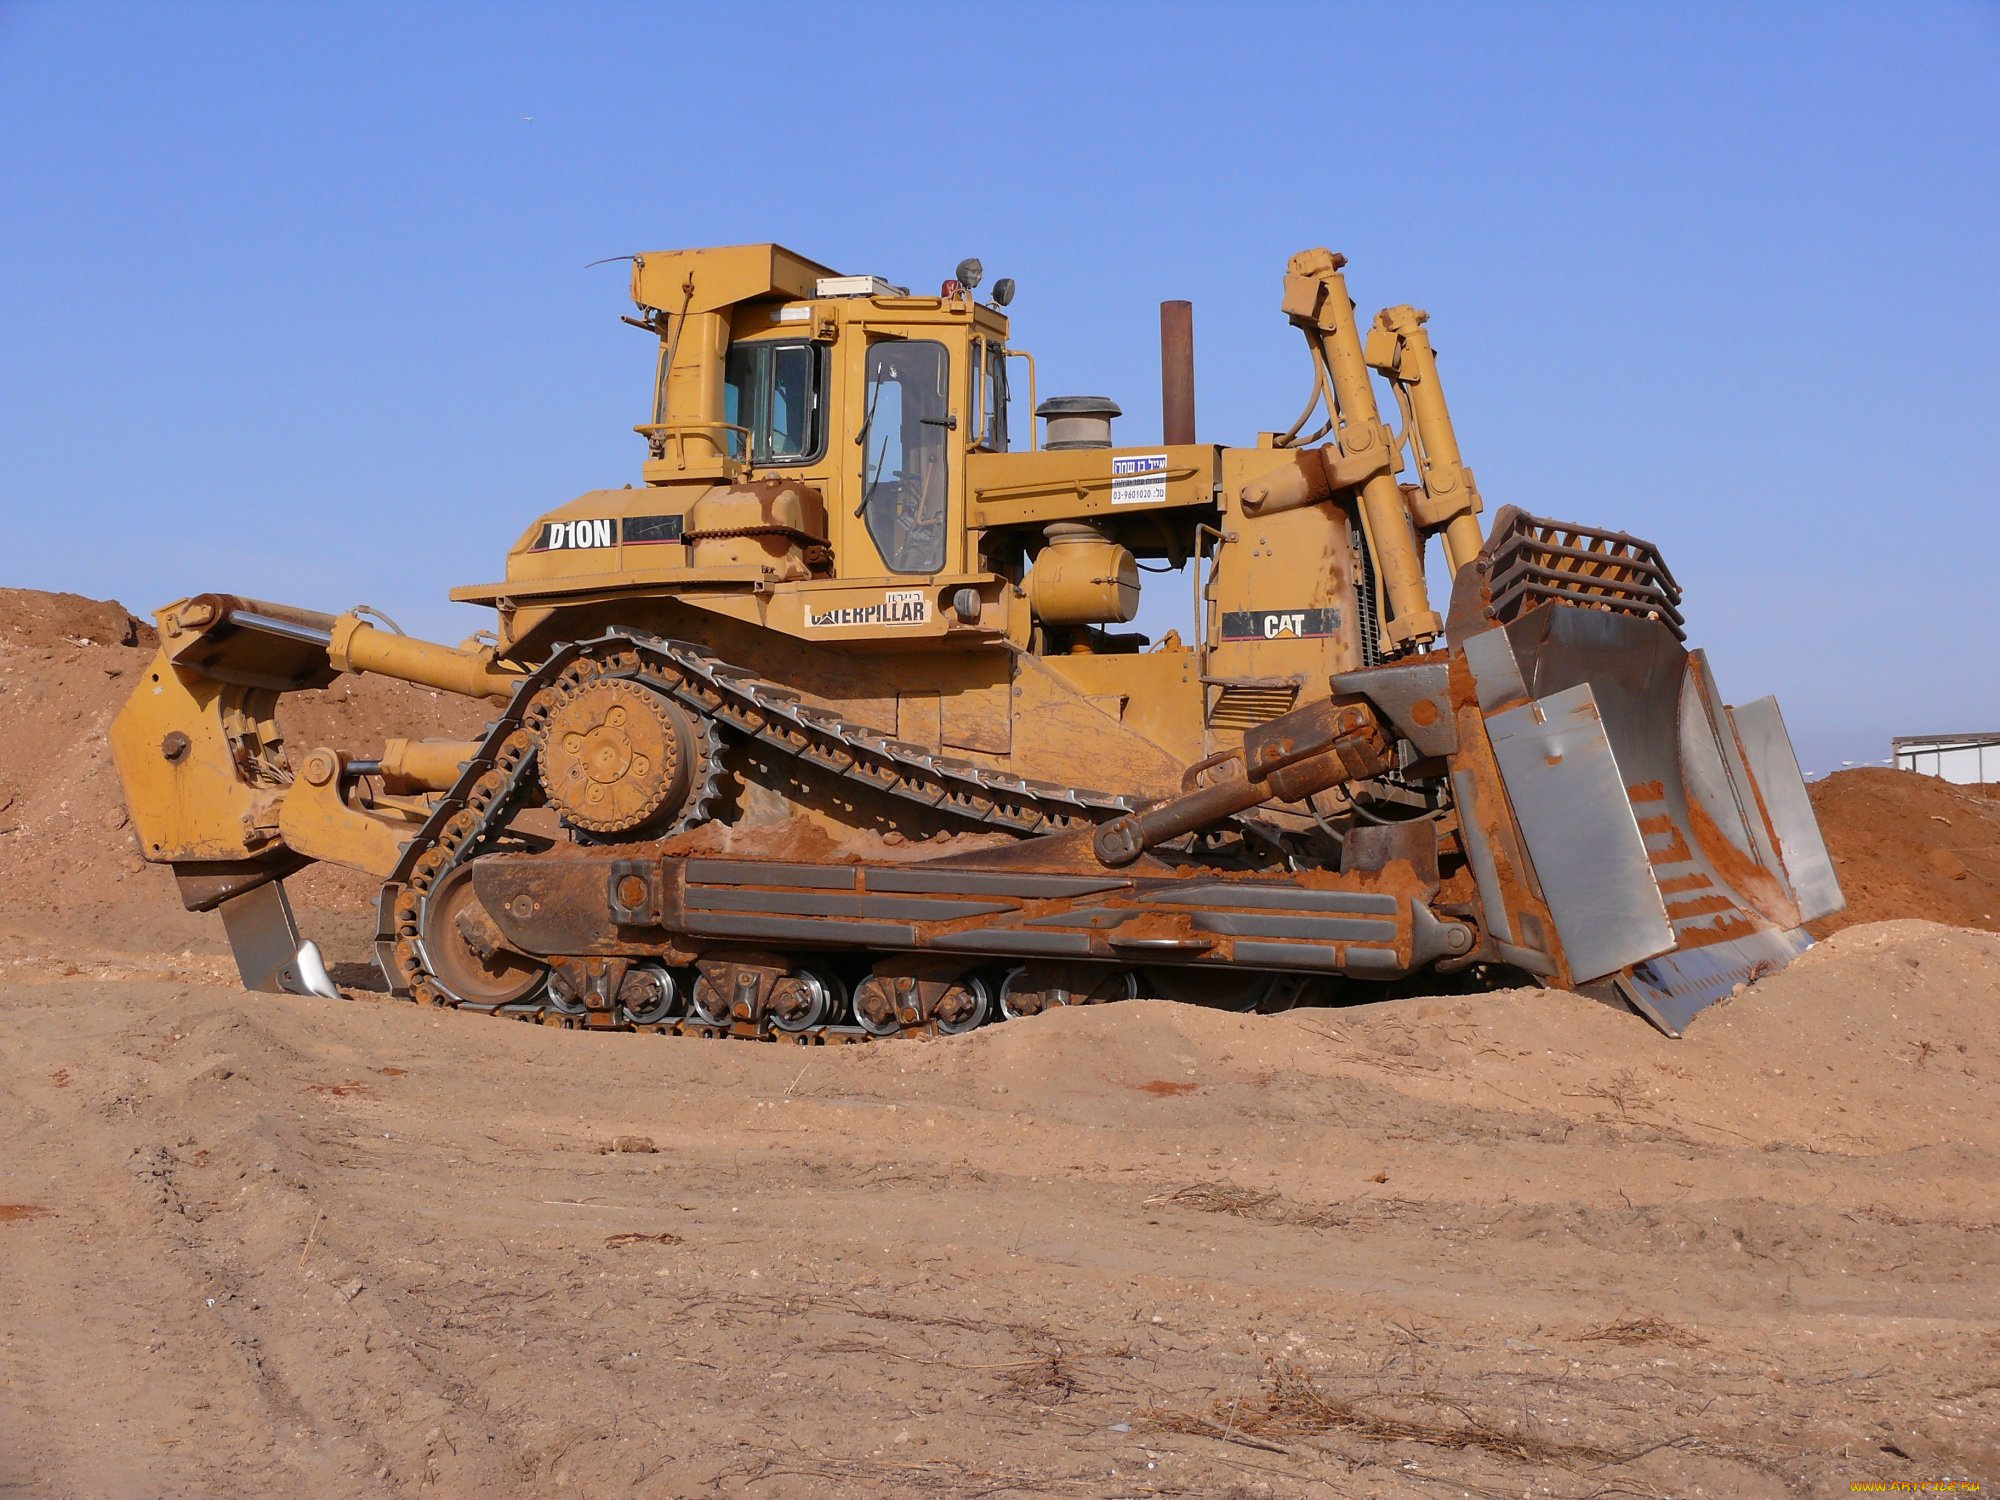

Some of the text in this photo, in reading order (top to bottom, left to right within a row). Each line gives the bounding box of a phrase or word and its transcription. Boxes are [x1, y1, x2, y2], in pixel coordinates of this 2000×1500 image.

[1137, 461, 1146, 473] בן
[549, 520, 611, 550] D10N
[1264, 614, 1304, 639] CAT
